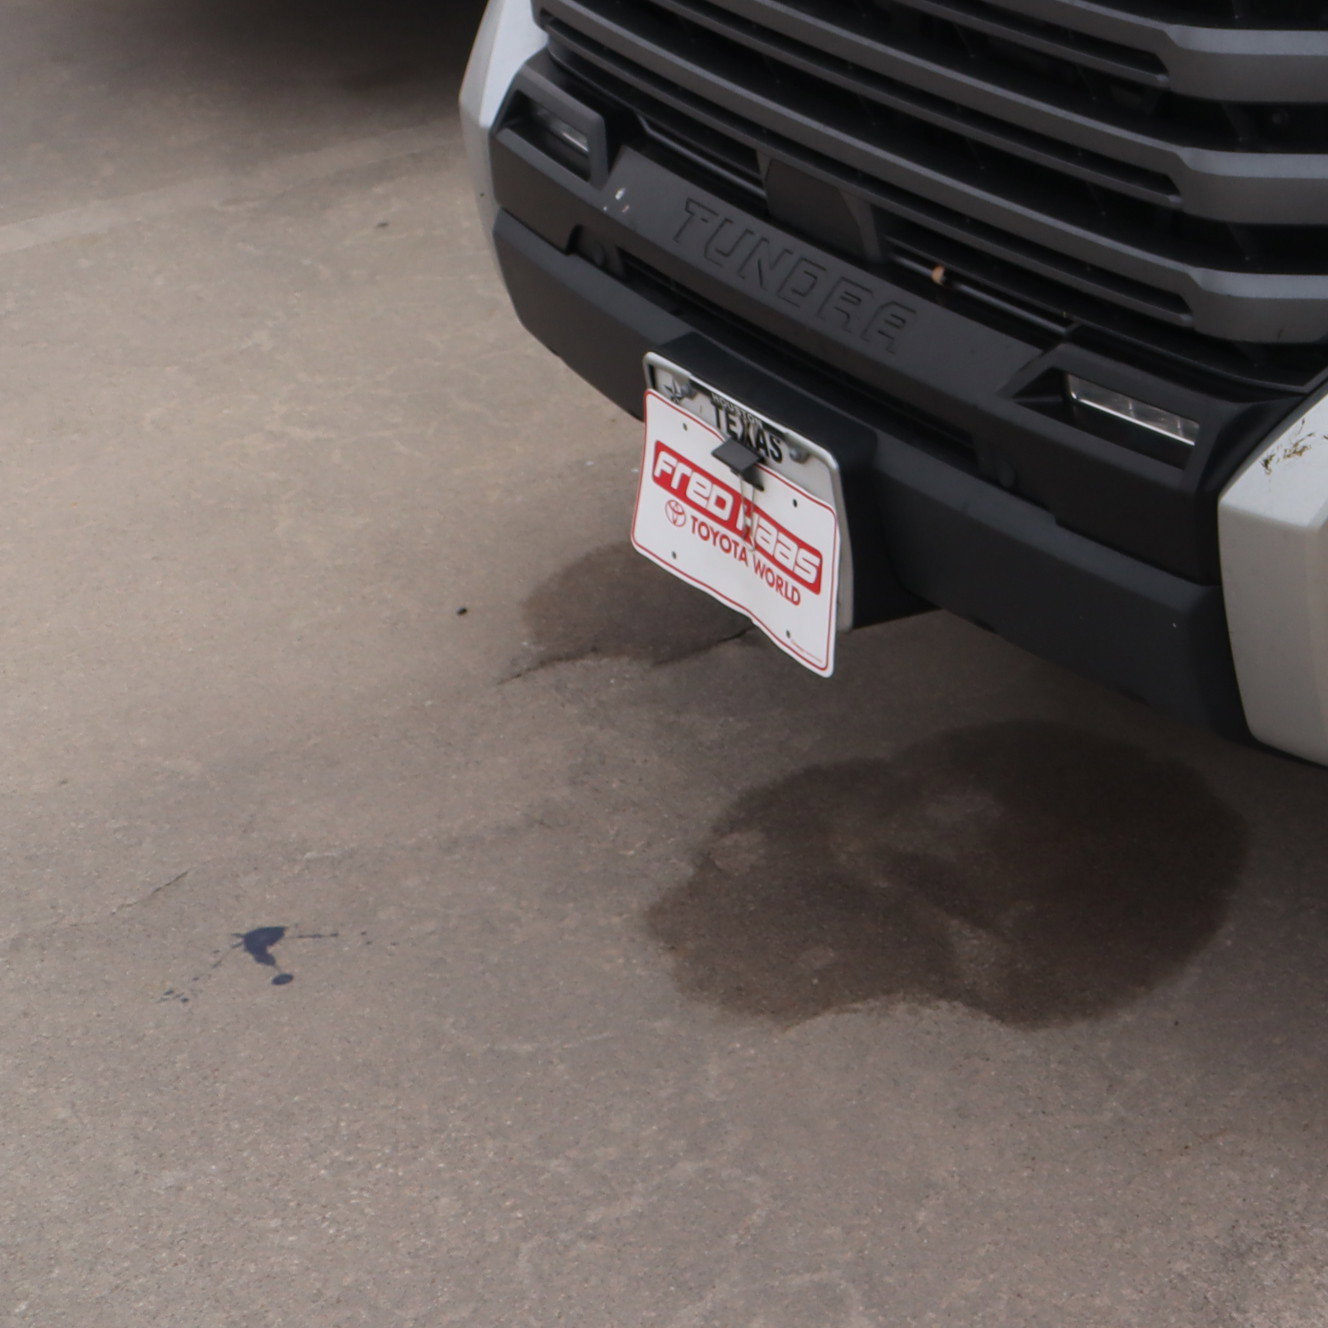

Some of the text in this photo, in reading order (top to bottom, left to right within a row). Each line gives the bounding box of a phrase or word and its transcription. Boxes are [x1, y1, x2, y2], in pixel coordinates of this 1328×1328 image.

[672, 197, 918, 356] TUNDRA
[713, 399, 783, 464] TEXAS
[690, 514, 801, 606] TOYOTA WORLD
